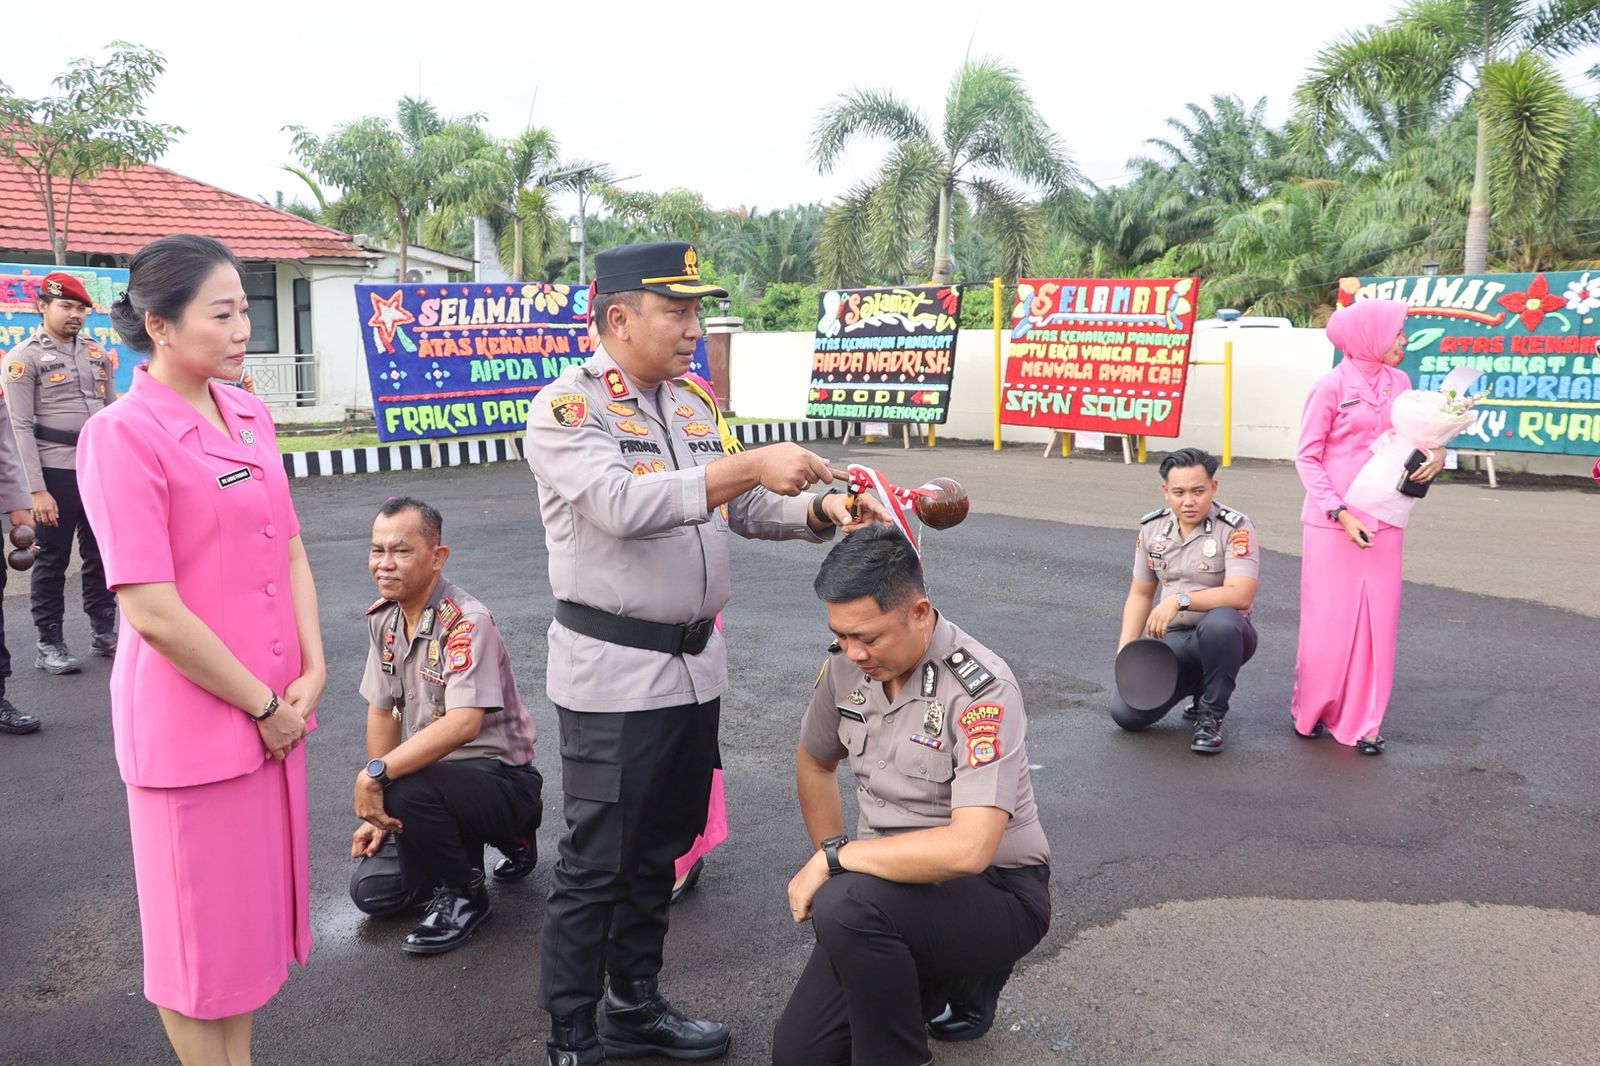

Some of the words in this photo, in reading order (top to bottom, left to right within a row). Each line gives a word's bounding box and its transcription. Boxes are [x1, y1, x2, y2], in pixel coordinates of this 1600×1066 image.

[418, 297, 533, 326] SELAMAT
[572, 289, 589, 315] S
[1031, 283, 1170, 316] SELAMAT
[418, 337, 473, 358] ATAS
[475, 335, 570, 359] KENAIKAN
[815, 337, 840, 350] ATAS
[842, 336, 896, 351] KENAIKAN
[1026, 330, 1058, 342] ATAS
[1061, 330, 1125, 344] KENAIKAN
[1127, 332, 1189, 347] PANGKAT
[1440, 336, 1504, 353] ATAS
[812, 352, 864, 373] AIPDA
[1048, 343, 1078, 362] EKA
[470, 357, 539, 383] AIPDA
[1021, 361, 1093, 380] MENYALA
[1099, 364, 1144, 383] AYAH
[385, 402, 478, 436] FRAKSI
[883, 406, 944, 421] DEMOKRAT
[1080, 394, 1172, 426] SQUAD
[961, 706, 1000, 725] POLRES
[967, 724, 997, 734] LAMPUNG
